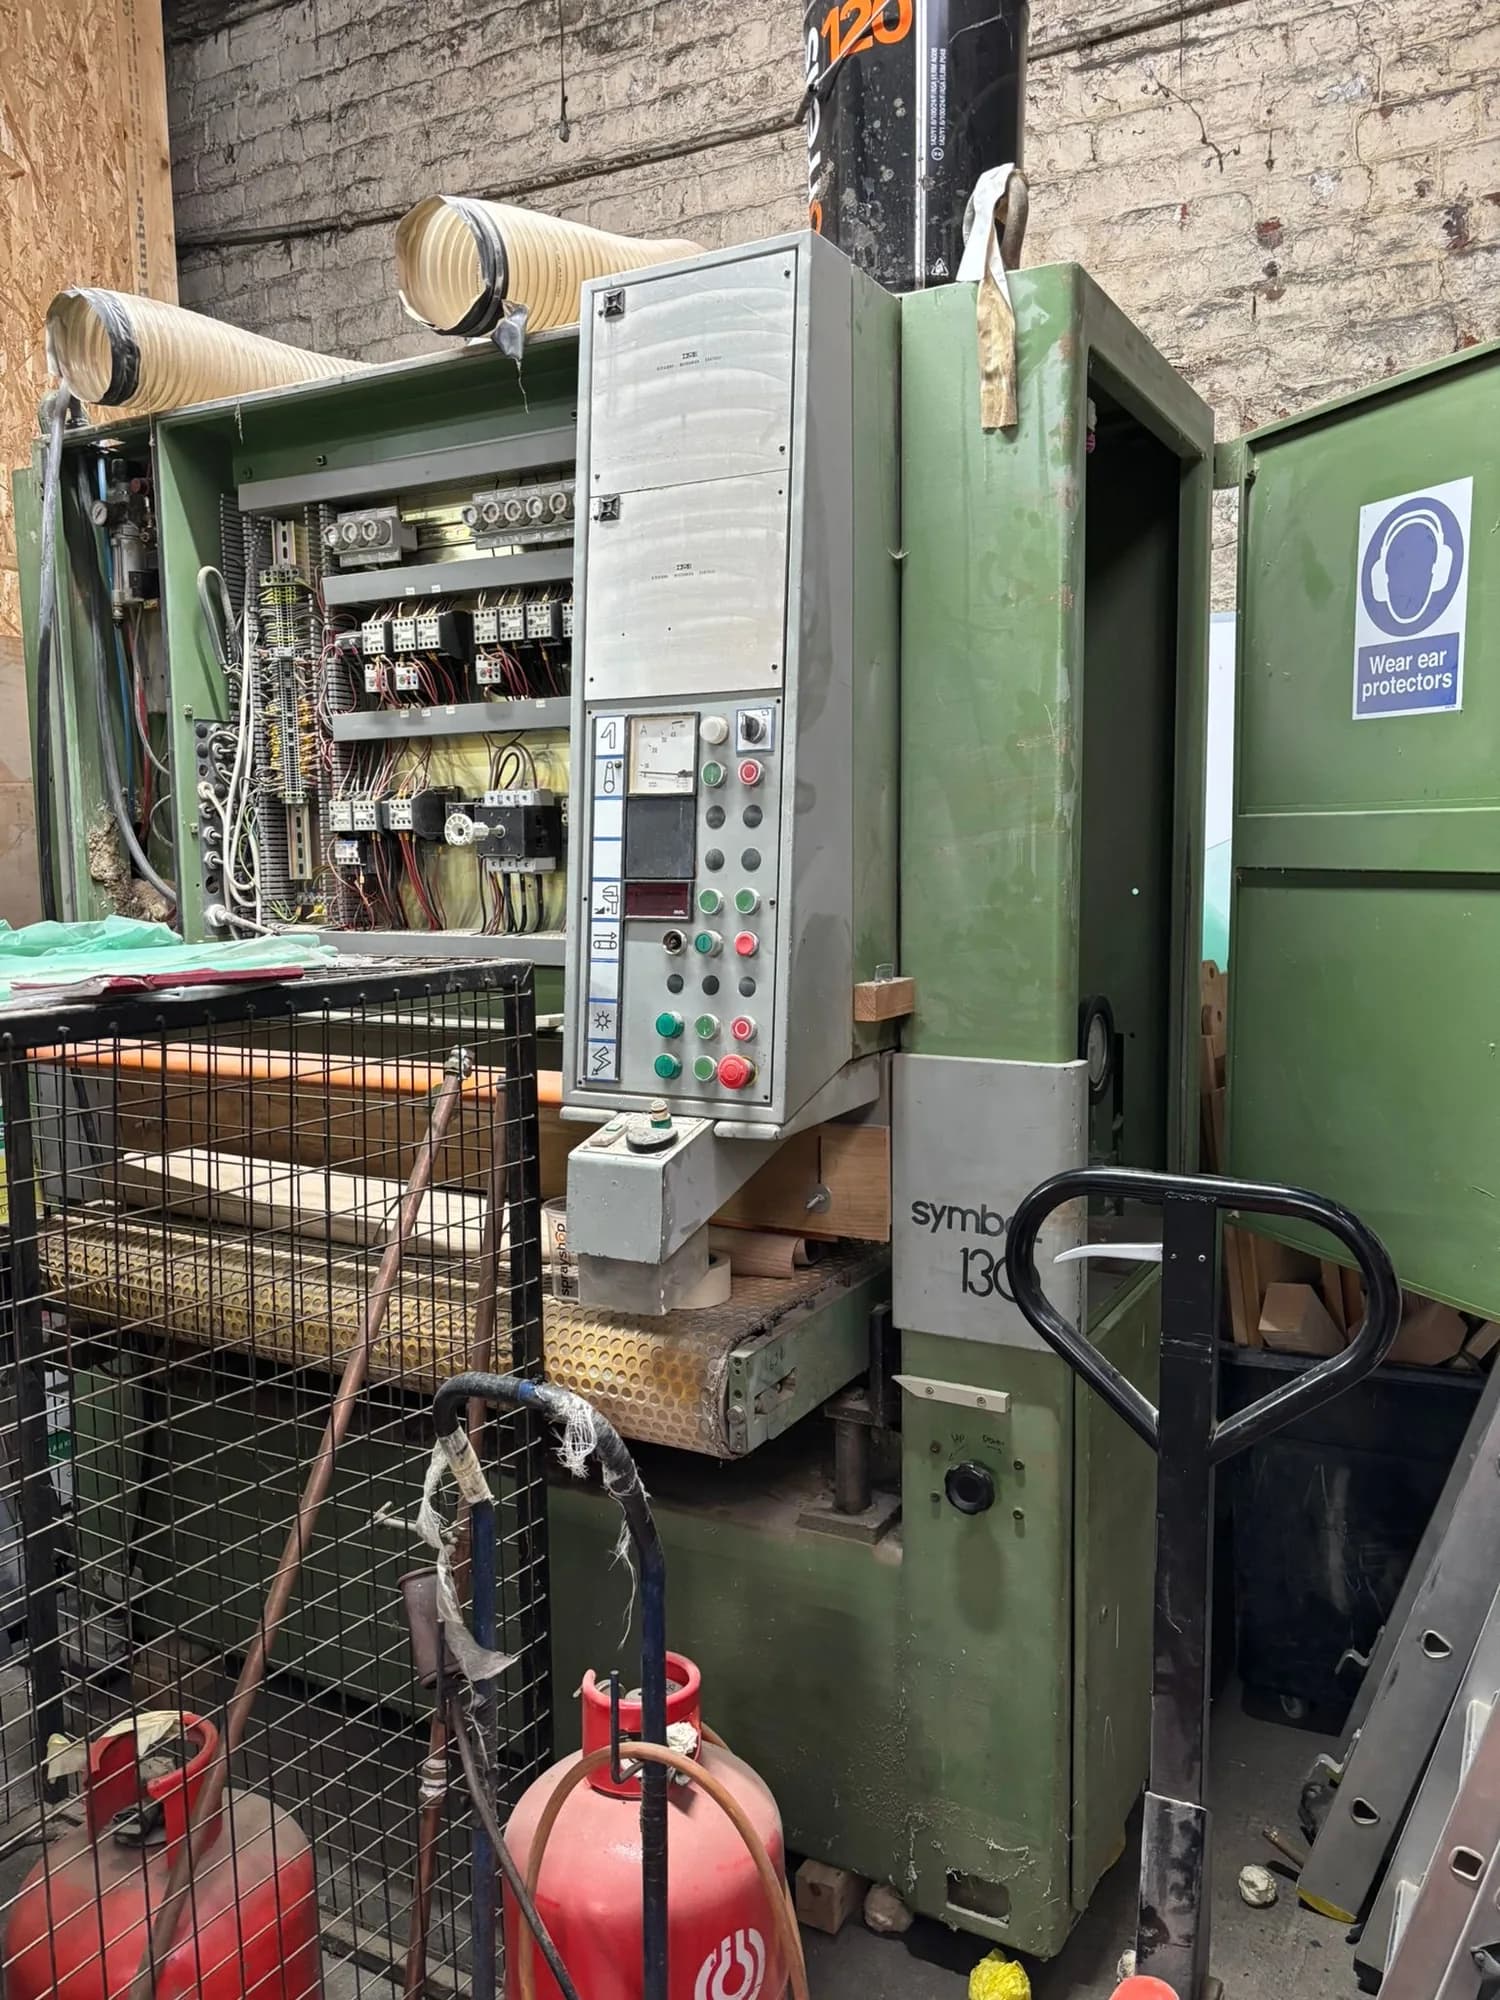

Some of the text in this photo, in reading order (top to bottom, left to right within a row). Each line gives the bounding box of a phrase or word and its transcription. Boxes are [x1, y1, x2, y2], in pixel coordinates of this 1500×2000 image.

[821, 0, 912, 63] 120
[1369, 649, 1447, 675] Wear ear
[1362, 672, 1453, 702] protectors
[555, 1223, 573, 1297] sprayshop
